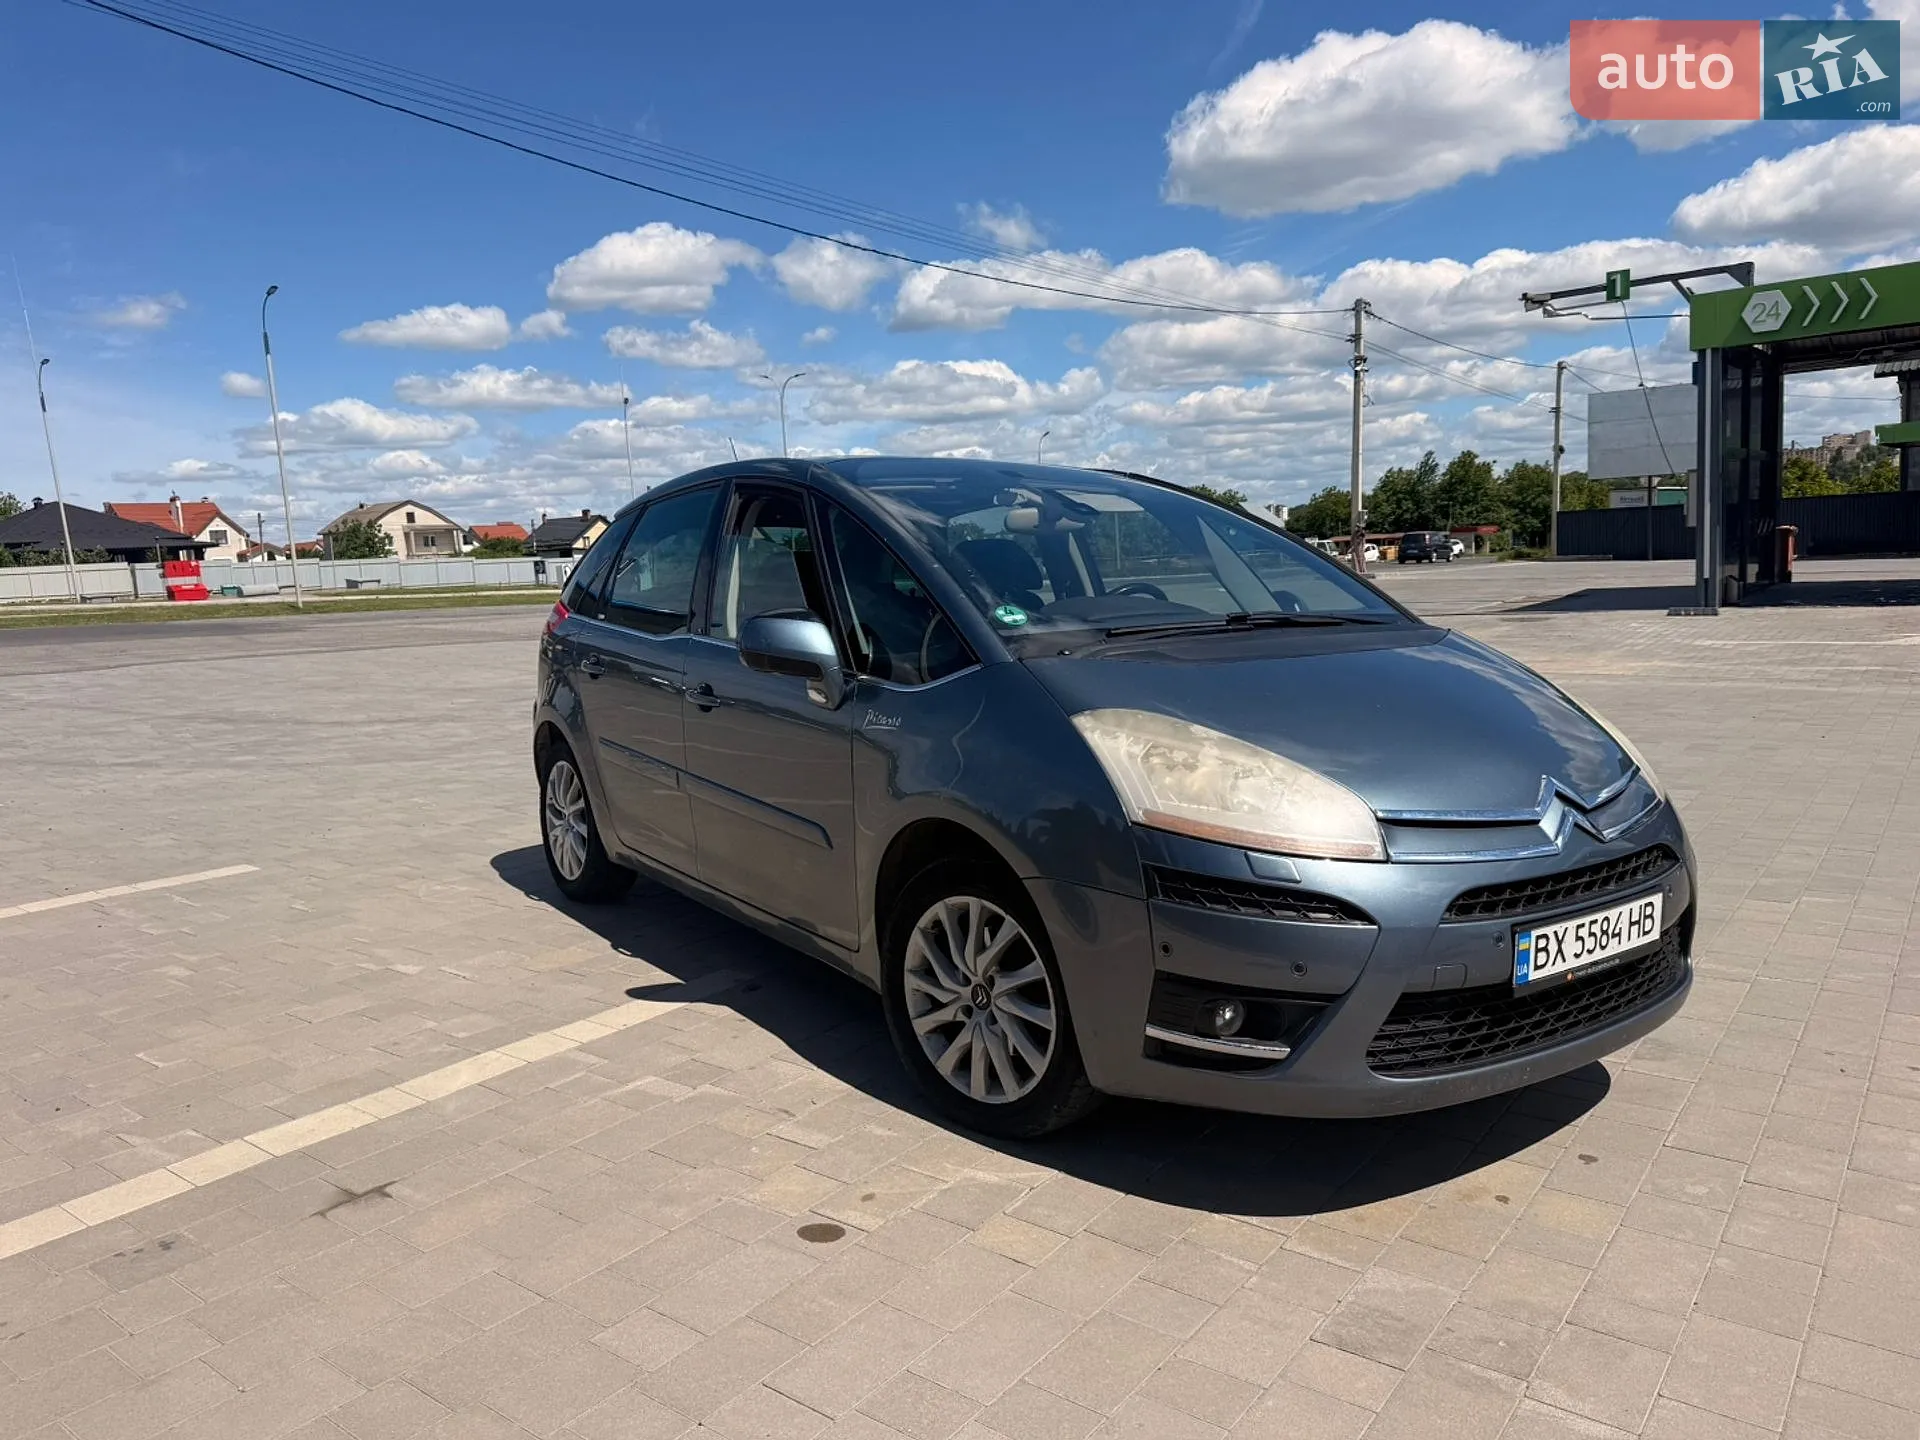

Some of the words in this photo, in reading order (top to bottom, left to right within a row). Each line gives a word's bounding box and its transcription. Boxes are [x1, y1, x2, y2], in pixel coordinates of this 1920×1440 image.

[1610, 273, 1620, 297] 1
[1751, 300, 1781, 324] 24
[1534, 927, 1568, 971] BX
[1573, 911, 1622, 958] 5584
[1627, 901, 1655, 942] HB
[1517, 963, 1528, 976] UA
